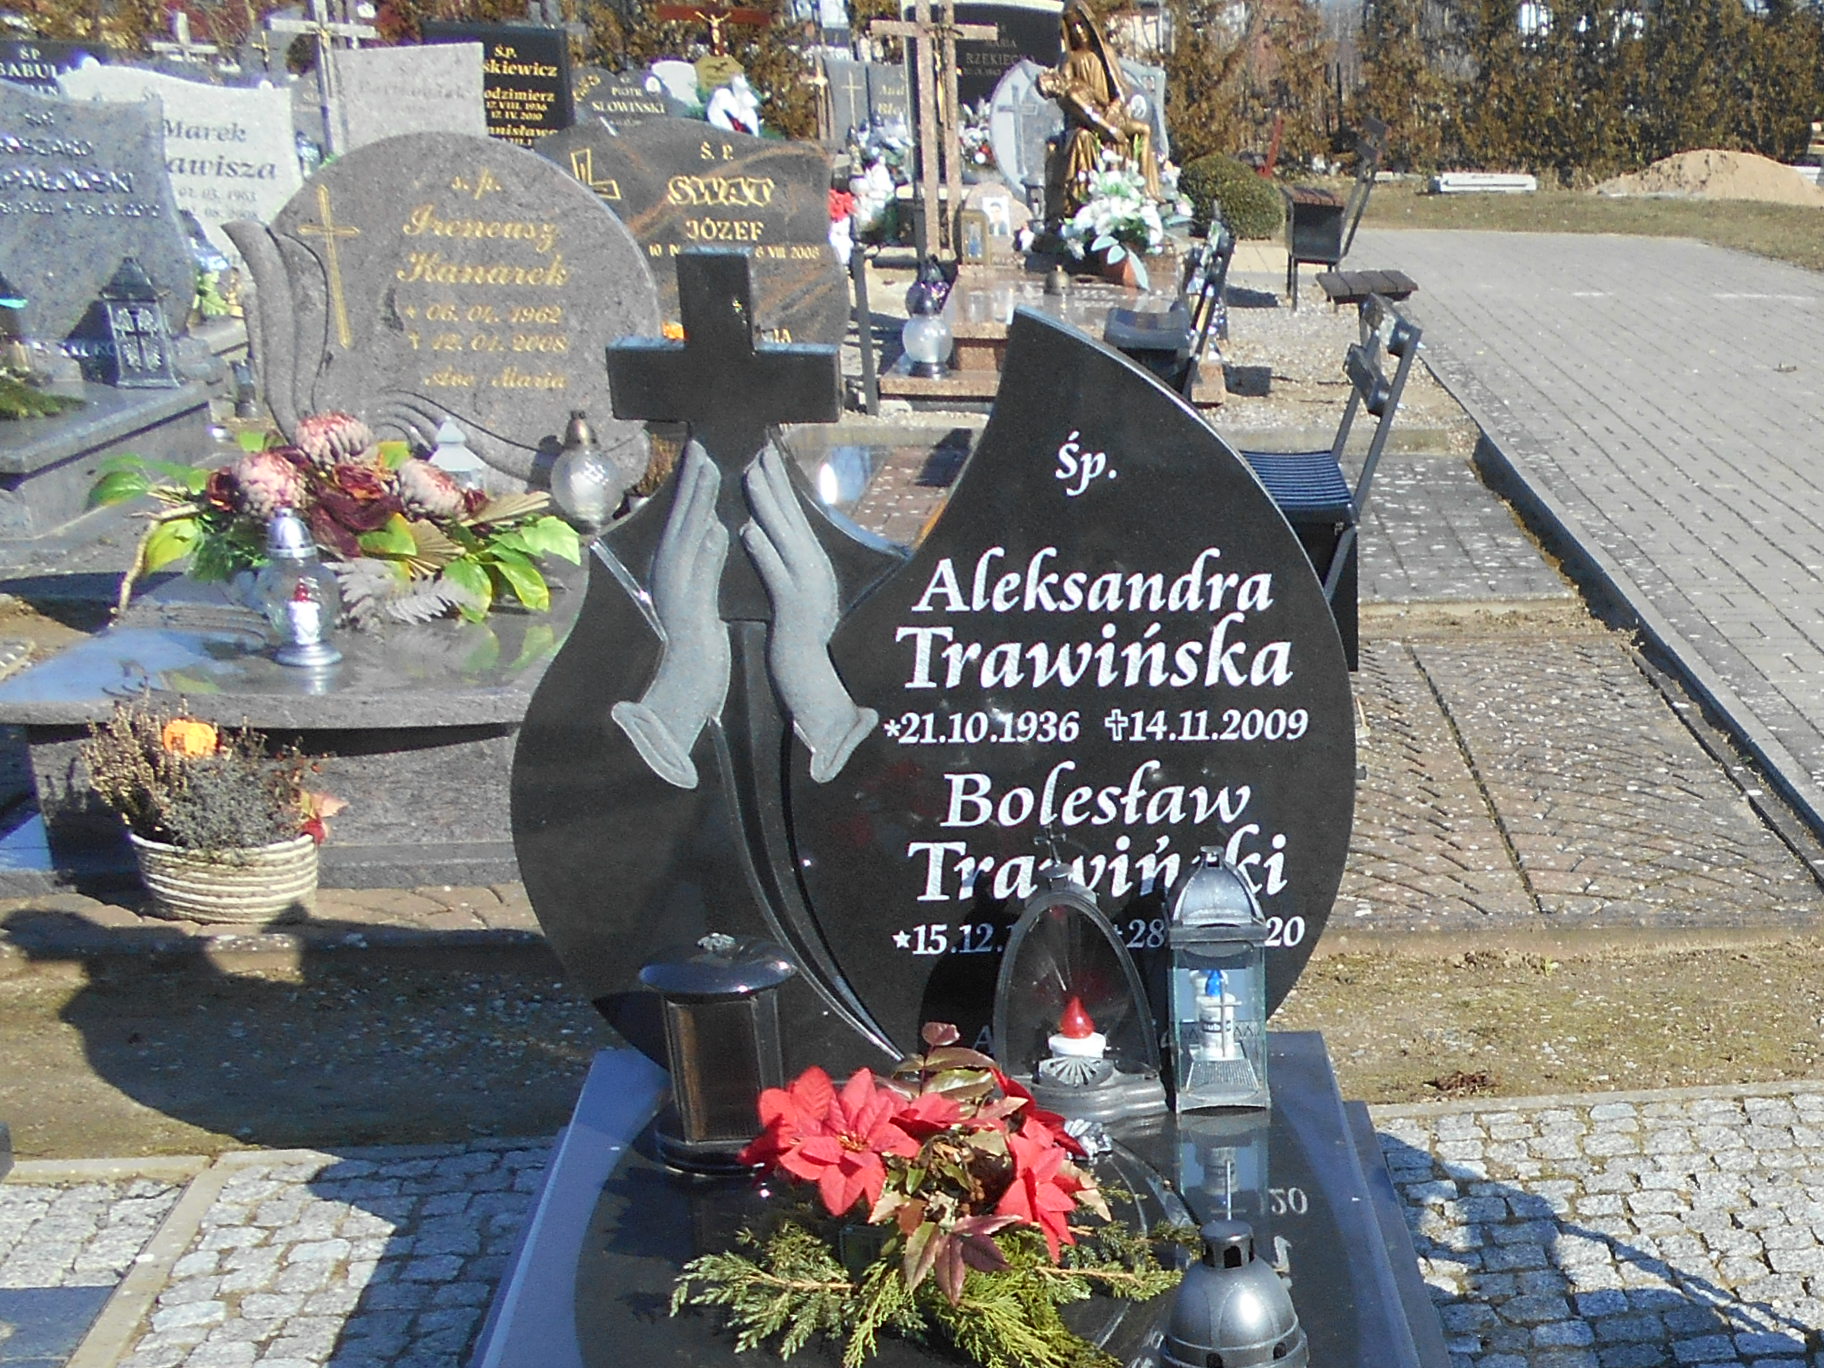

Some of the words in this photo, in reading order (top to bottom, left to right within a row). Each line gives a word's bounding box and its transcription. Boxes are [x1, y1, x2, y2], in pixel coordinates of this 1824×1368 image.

[611, 87, 643, 97] PIOTR
[163, 119, 247, 143] Marek
[168, 155, 277, 180] awisza
[667, 175, 775, 208] SWAT
[403, 203, 557, 254] Ireneusz
[686, 217, 764, 241] JÓZEF
[396, 251, 569, 287] Kanarek
[511, 305, 563, 324] 1962
[512, 333, 568, 353] 2008
[1056, 431, 1117, 496] śp.
[912, 547, 1275, 613] Aleksandra
[896, 612, 1293, 689] Trawińska
[940, 760, 1252, 828] Bolesław
[907, 824, 1289, 902] Trawińki
